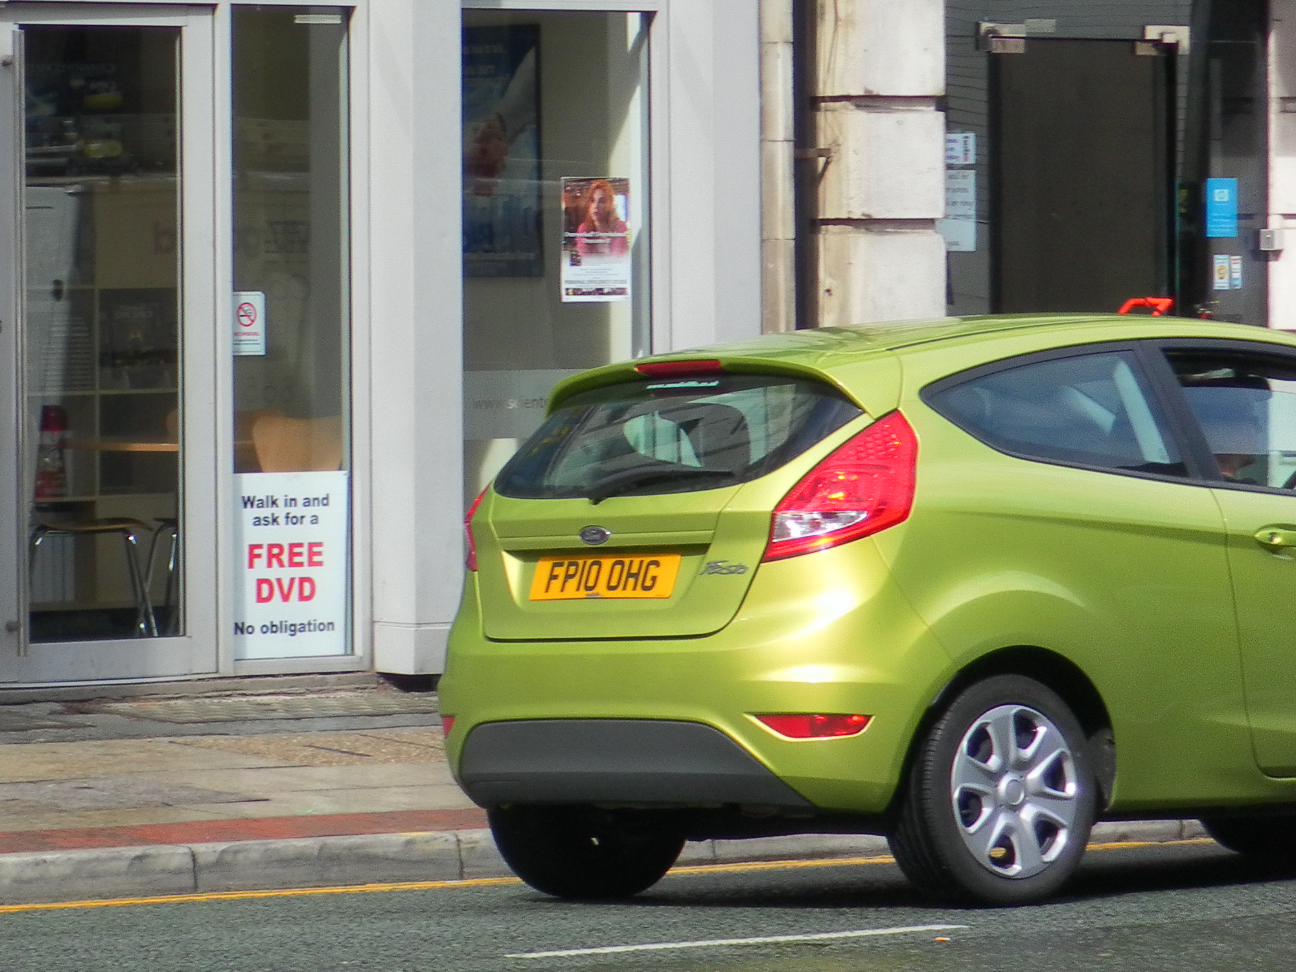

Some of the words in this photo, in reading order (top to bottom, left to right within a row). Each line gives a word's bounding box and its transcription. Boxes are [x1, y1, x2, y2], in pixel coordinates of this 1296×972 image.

[241, 495, 280, 510] Walk
[284, 495, 298, 509] in
[303, 494, 330, 508] and
[252, 513, 280, 527] ask
[284, 512, 306, 526] for
[310, 515, 319, 525] a
[247, 542, 325, 569] FREE
[544, 560, 603, 594] FP10
[606, 558, 661, 592] OHG
[255, 577, 317, 603] DVD
[234, 621, 254, 635] No
[260, 619, 335, 639] obligation
